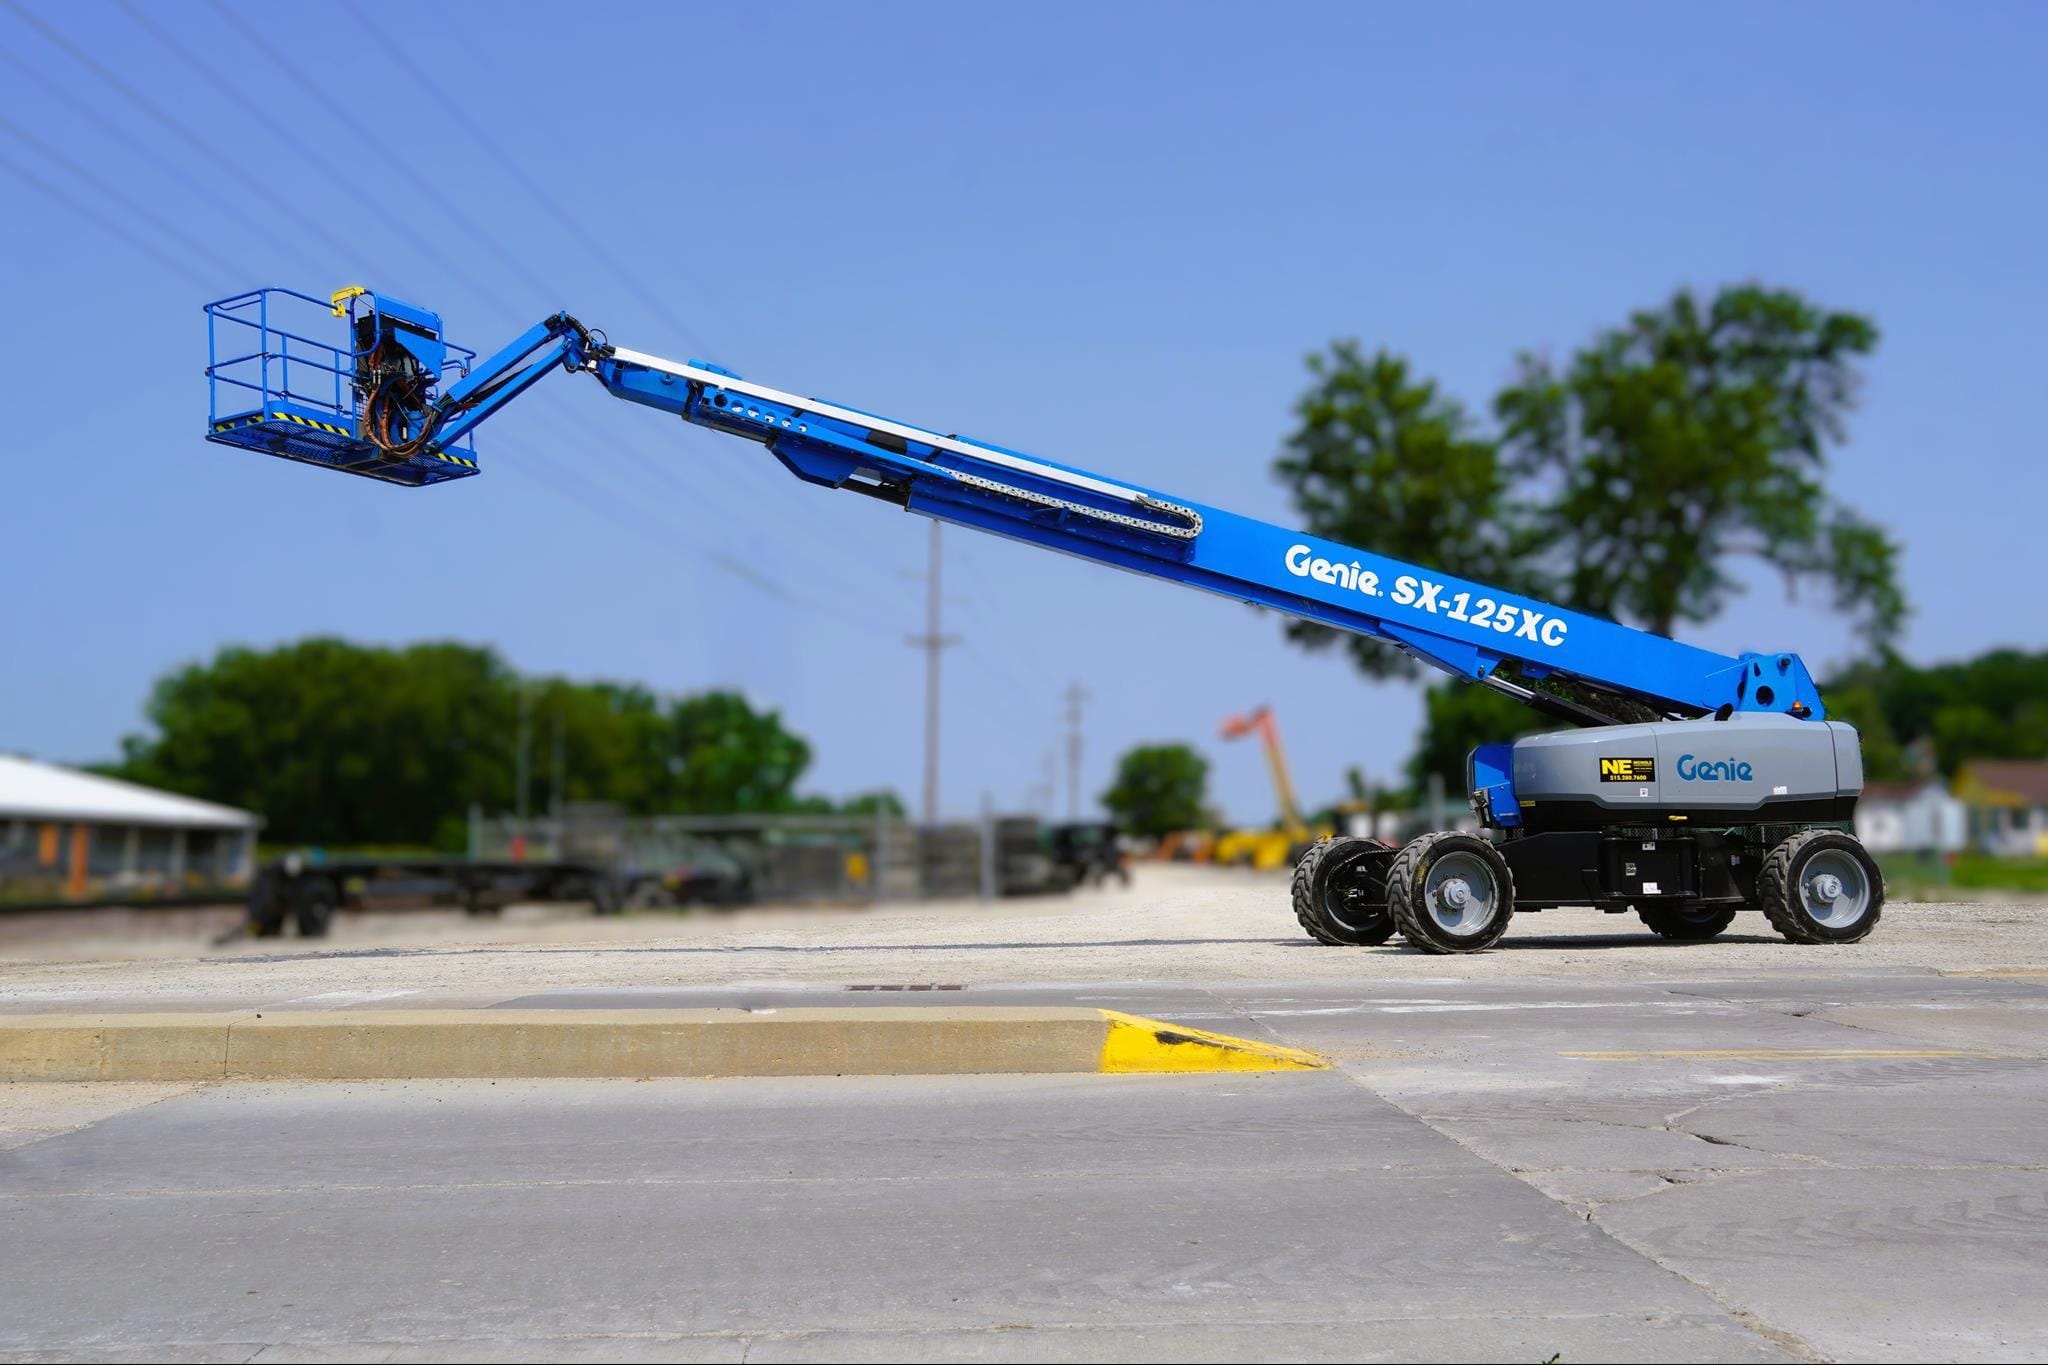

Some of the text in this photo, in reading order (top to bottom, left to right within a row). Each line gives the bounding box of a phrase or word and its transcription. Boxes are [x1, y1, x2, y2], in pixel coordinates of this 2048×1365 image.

[1285, 544, 1568, 647] Genie SX-125XC
[1601, 759, 1633, 774] NE
[1676, 754, 1753, 781] Genie
